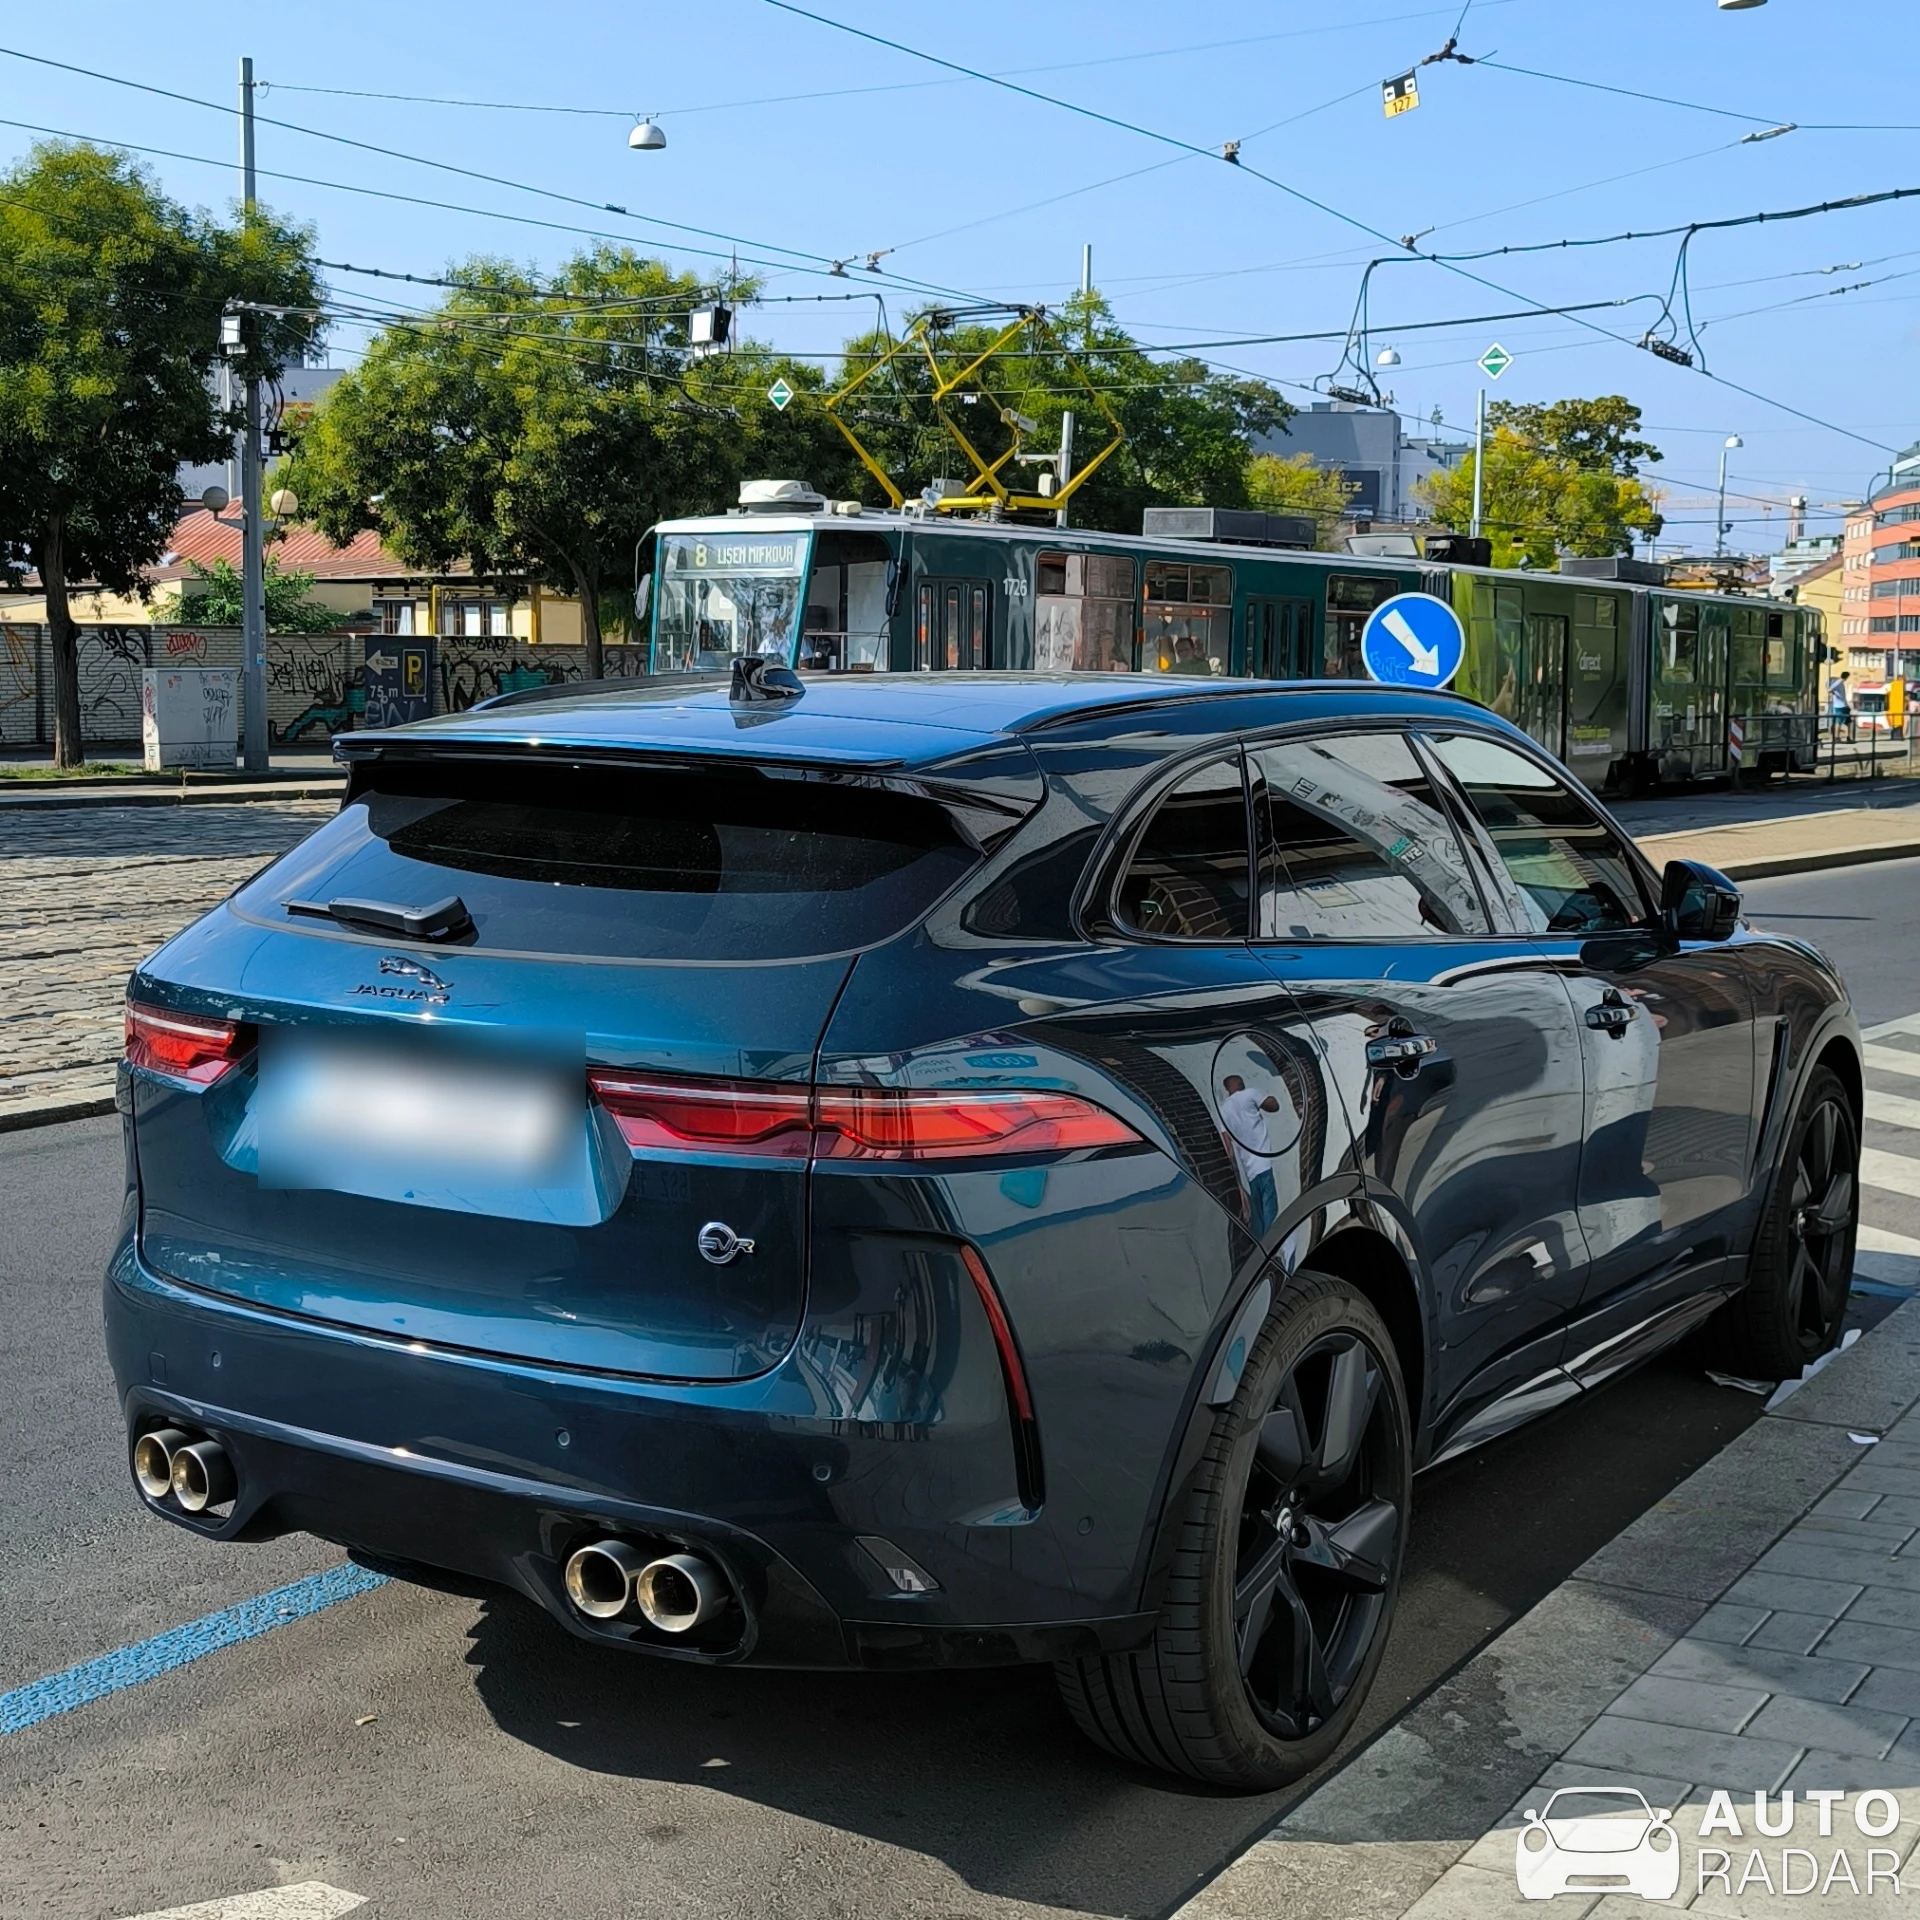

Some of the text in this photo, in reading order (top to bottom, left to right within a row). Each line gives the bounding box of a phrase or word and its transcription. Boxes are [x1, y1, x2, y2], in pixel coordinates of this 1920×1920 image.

[1393, 97, 1411, 113] 127
[695, 543, 708, 568] 8
[748, 545, 794, 564] MIFKOVA
[1003, 578, 1028, 597] 1726
[407, 655, 422, 684] P
[369, 685, 399, 698] 75 m
[345, 984, 451, 1006] JAGUAR
